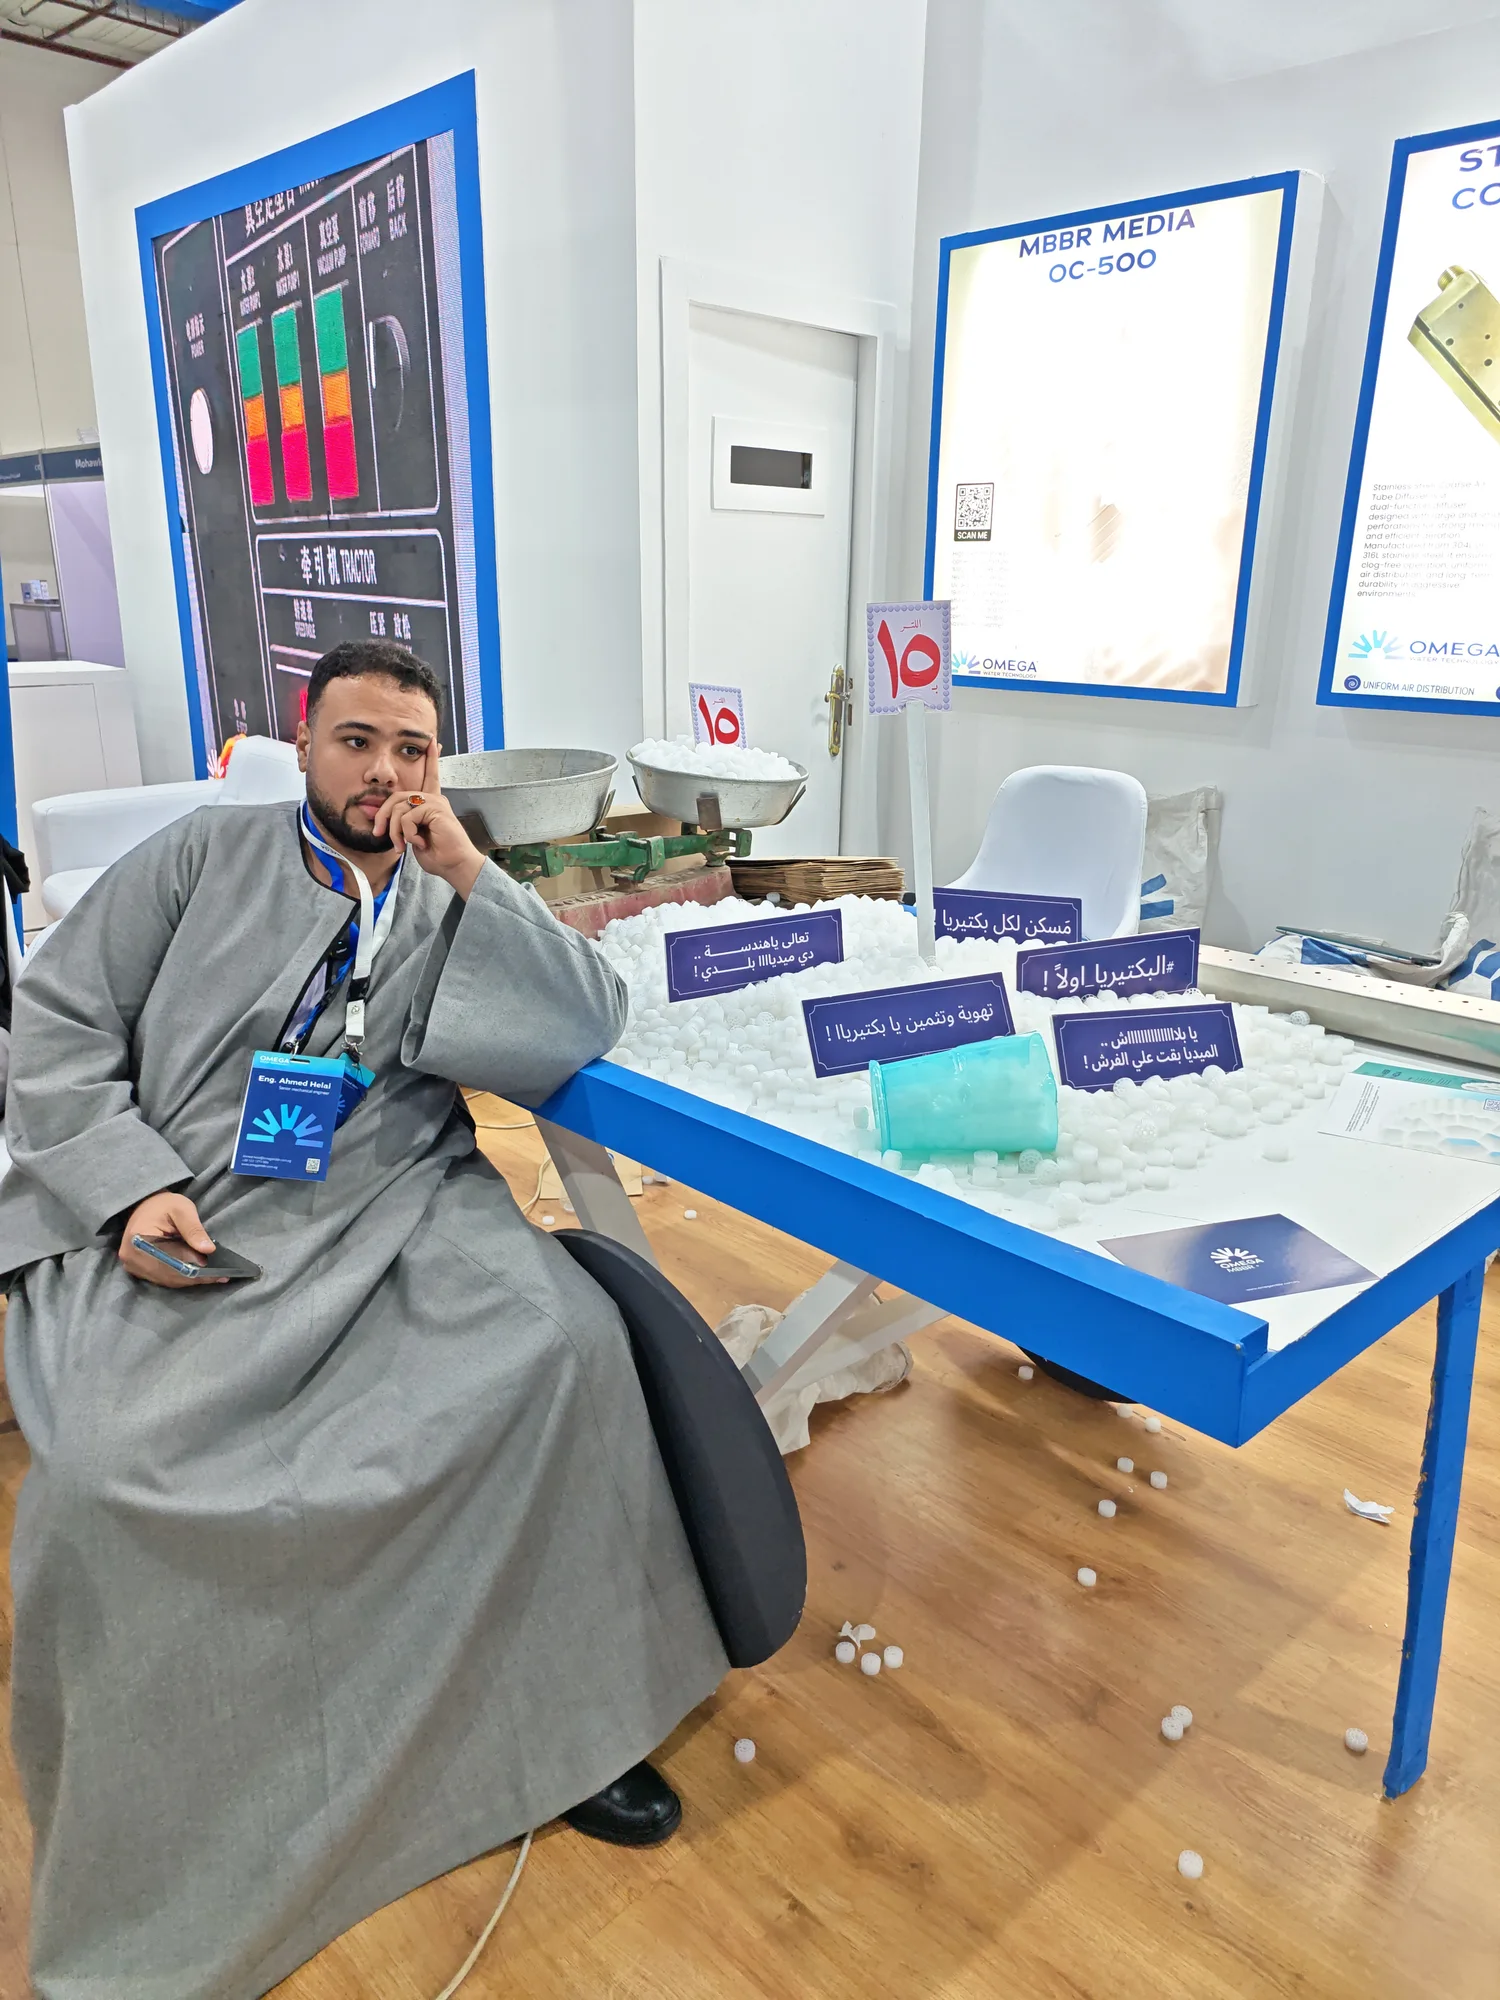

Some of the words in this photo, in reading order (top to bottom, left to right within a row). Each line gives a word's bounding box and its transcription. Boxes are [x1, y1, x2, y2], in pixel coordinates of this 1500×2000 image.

[1459, 144, 1500, 172] ST
[388, 212, 408, 241] BACK
[1019, 227, 1092, 258] MBBR
[1103, 208, 1196, 243] MEDIA
[1049, 249, 1157, 283] OC-500
[1373, 483, 1411, 491] Stainless
[1372, 493, 1393, 501] Tube
[1369, 513, 1409, 522] designed
[957, 531, 977, 540] SCAN
[977, 531, 988, 539] ME
[300, 544, 341, 586] 牵引机
[340, 548, 378, 585] TRACTOR
[1361, 561, 1402, 570] clog-free
[1358, 580, 1398, 589] durability
[1409, 640, 1500, 657] OMEGA
[982, 658, 1037, 673] OMEGA
[1002, 671, 1037, 679] TECHNOLOGY
[1363, 681, 1400, 691] UNIFORM
[1401, 683, 1415, 692] AIR
[1416, 684, 1475, 696] DISTRIBUTION
[943, 909, 989, 933] بكتيريا
[993, 913, 1020, 935] لكل
[958, 1003, 994, 1023] تهوية
[889, 1016, 901, 1035] يا
[905, 1010, 955, 1033] وتثمين
[1187, 1026, 1198, 1043] يا
[259, 1055, 290, 1064] OMEGA
[1091, 1051, 1129, 1072] الفرش
[1156, 1048, 1182, 1064] بقت
[1182, 1044, 1219, 1063] الميديا
[258, 1075, 276, 1084] Eng.
[278, 1077, 308, 1087] Ahmed
[309, 1081, 332, 1090] Helal
[1220, 1258, 1264, 1269] OMEGA
[1226, 1265, 1255, 1273] MBBR
